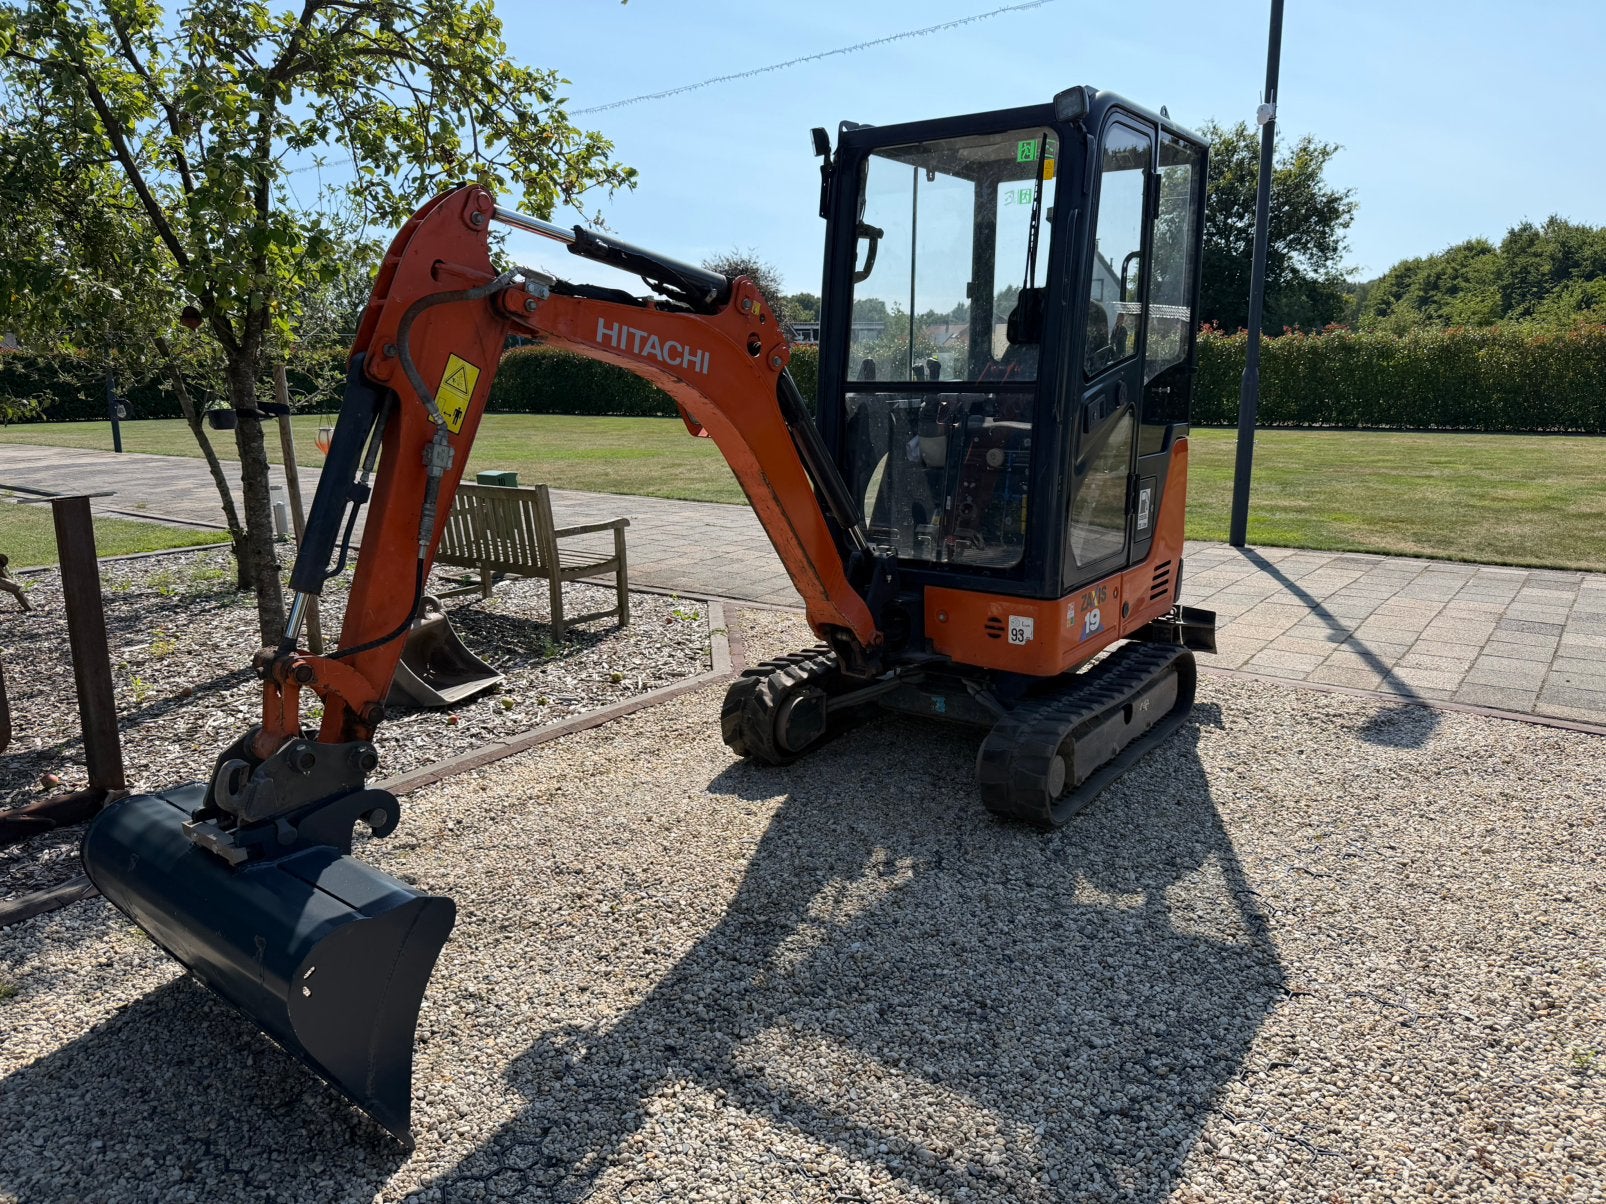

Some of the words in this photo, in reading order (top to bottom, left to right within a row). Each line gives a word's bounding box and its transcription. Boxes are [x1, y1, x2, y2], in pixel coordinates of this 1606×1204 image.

[596, 317, 710, 375] HITACHI
[1085, 608, 1101, 634] 19
[1011, 628, 1024, 642] 93
